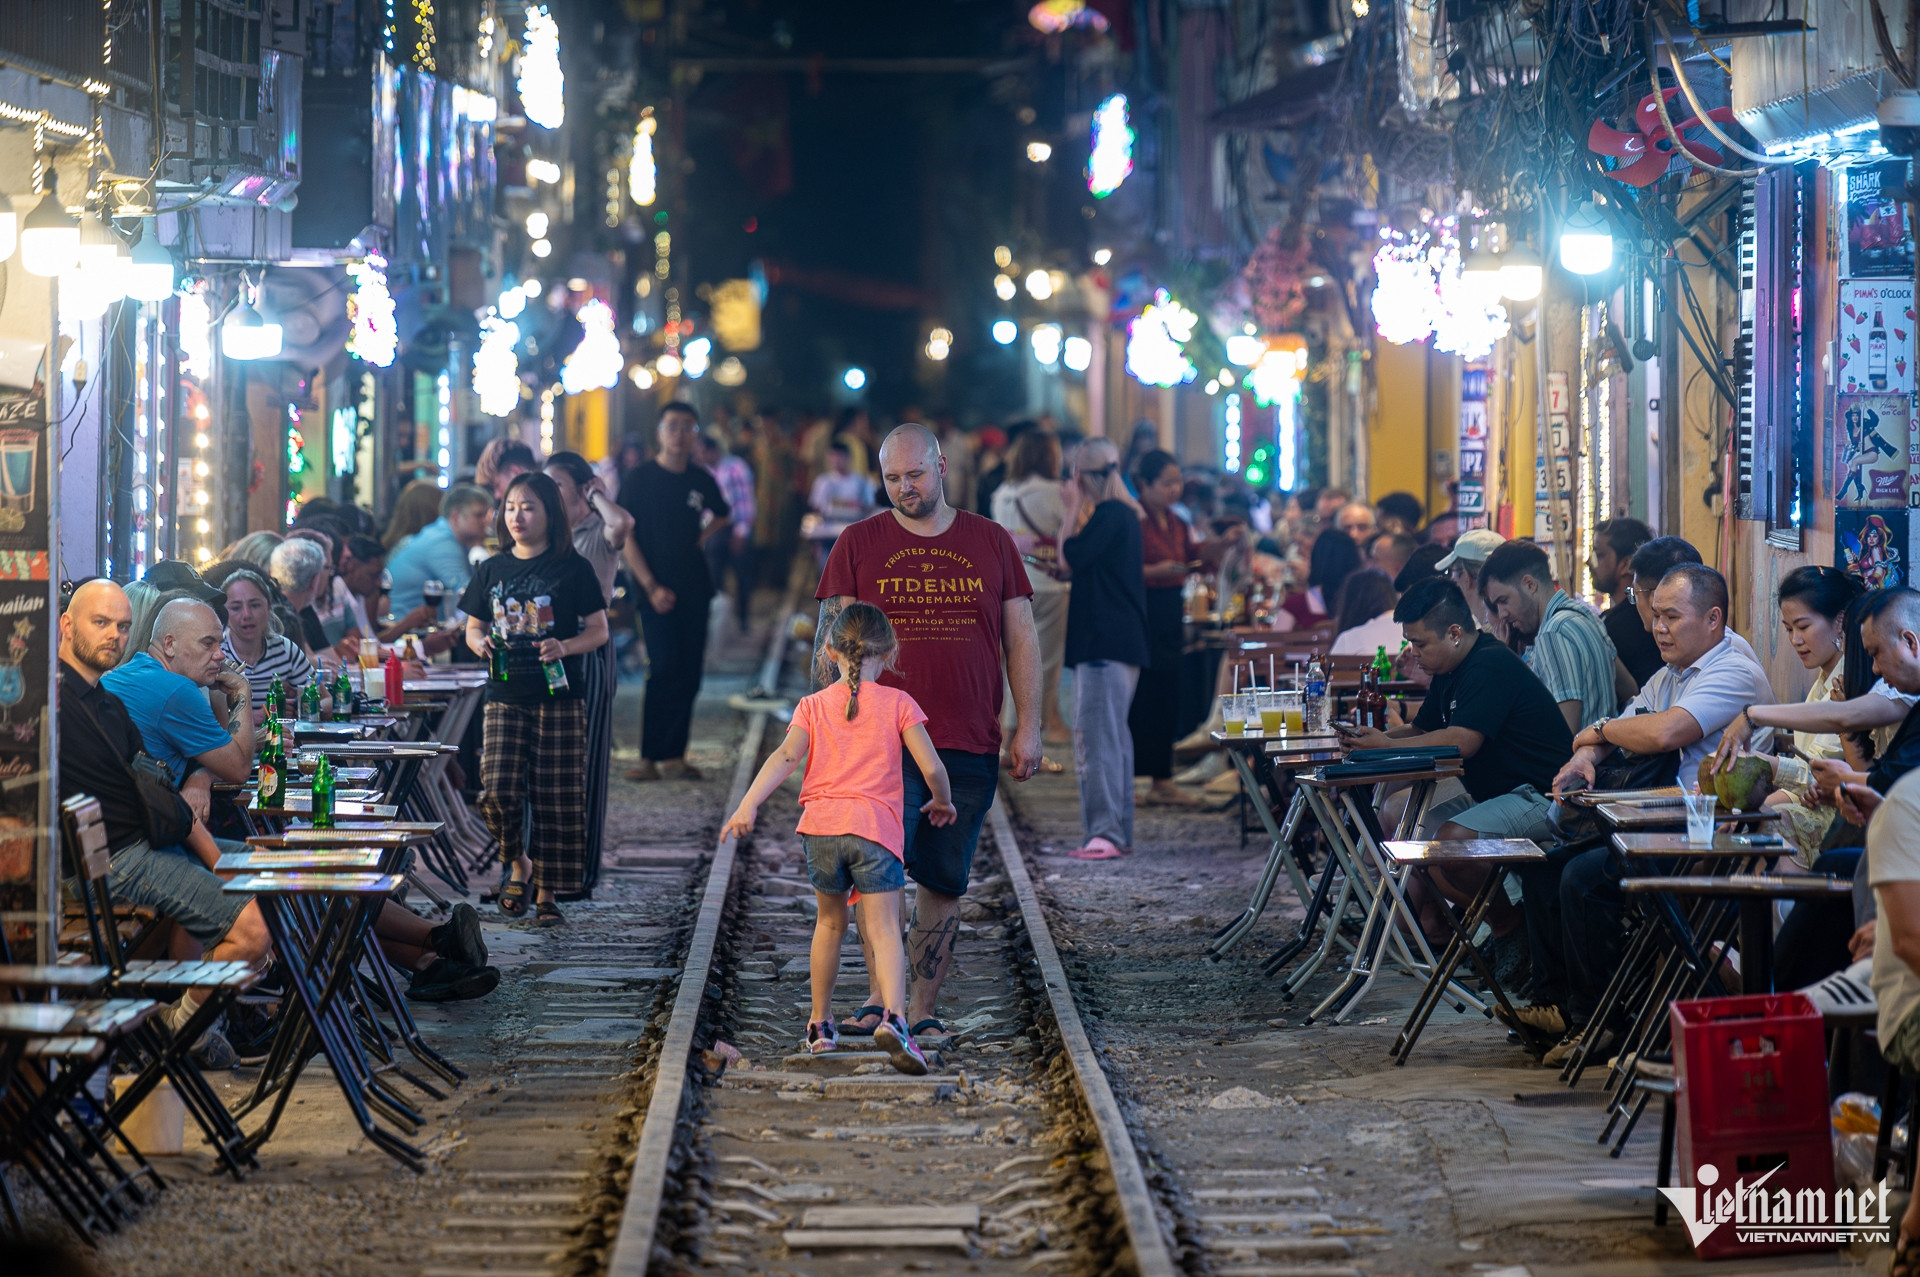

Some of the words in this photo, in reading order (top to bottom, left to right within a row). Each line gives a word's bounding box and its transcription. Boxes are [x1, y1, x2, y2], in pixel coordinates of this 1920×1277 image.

[1849, 171, 1881, 191] SHARK
[1854, 288, 1878, 298] PIMM'S
[1880, 288, 1912, 298] O'CLOCK
[885, 548, 926, 569] TRUSTED
[930, 548, 973, 569] QUALITY
[876, 577, 984, 594] TTDENIM
